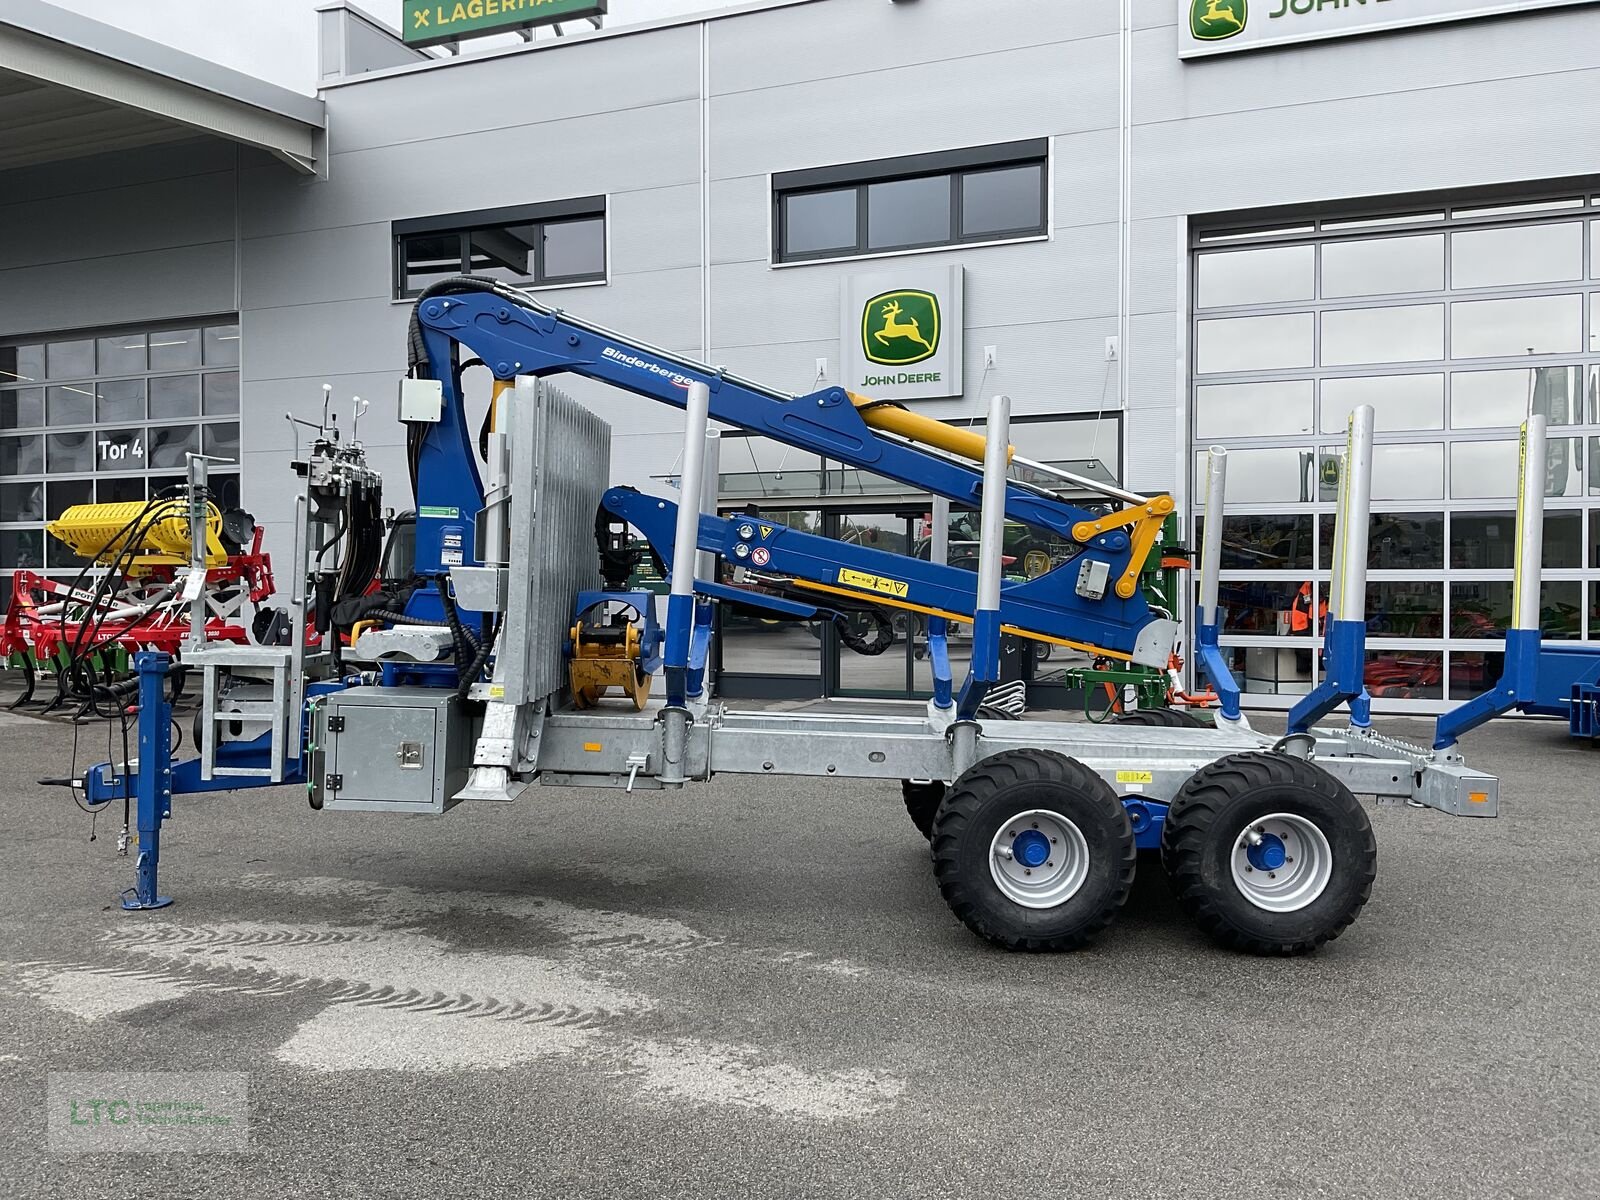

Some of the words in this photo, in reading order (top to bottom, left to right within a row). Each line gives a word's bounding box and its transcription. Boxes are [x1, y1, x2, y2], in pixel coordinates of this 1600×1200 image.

[602, 347, 697, 385] Binderberge
[861, 376, 896, 386] JOHN
[898, 372, 942, 384] DEERE
[98, 440, 128, 460] Tor
[132, 438, 144, 458] 4
[75, 591, 119, 607] PÖTTGR
